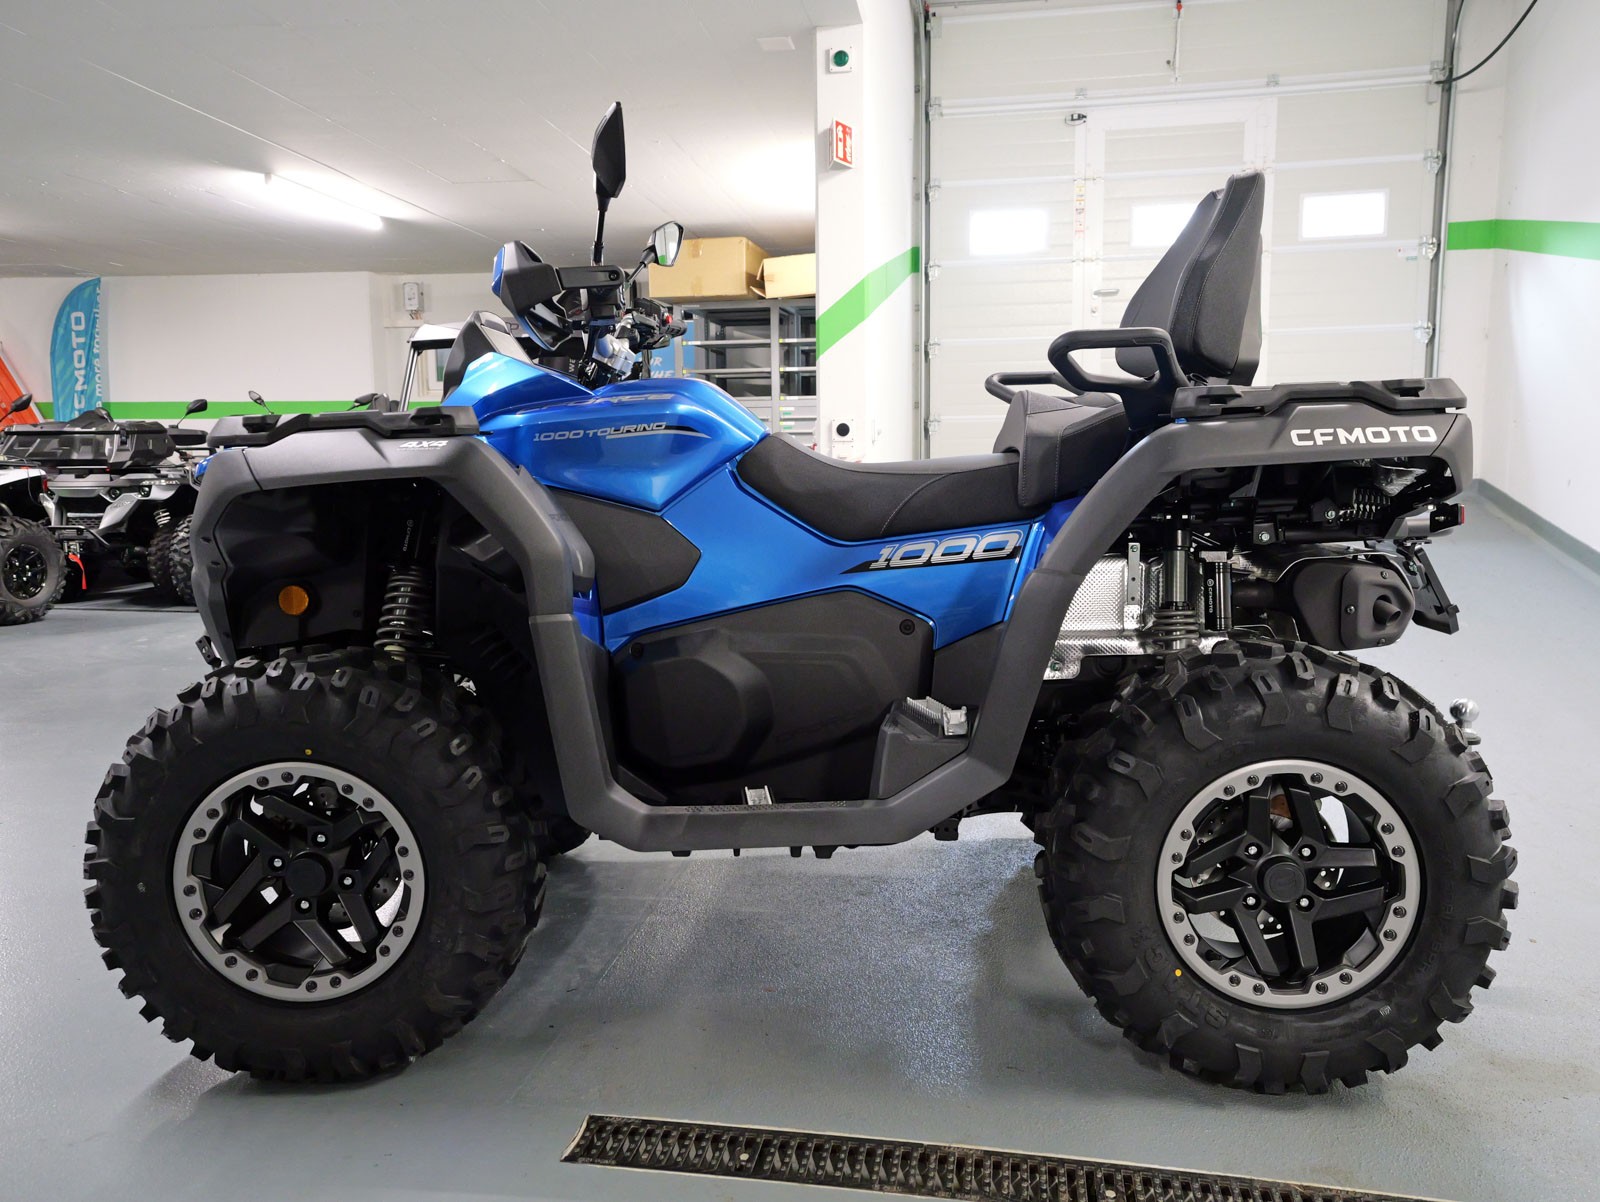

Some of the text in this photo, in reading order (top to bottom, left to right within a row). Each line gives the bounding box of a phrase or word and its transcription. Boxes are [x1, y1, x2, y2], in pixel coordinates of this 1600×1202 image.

[533, 422, 667, 442] 1000 TOURING
[1290, 425, 1438, 447] CFMOTO
[868, 529, 1024, 569] 1000
